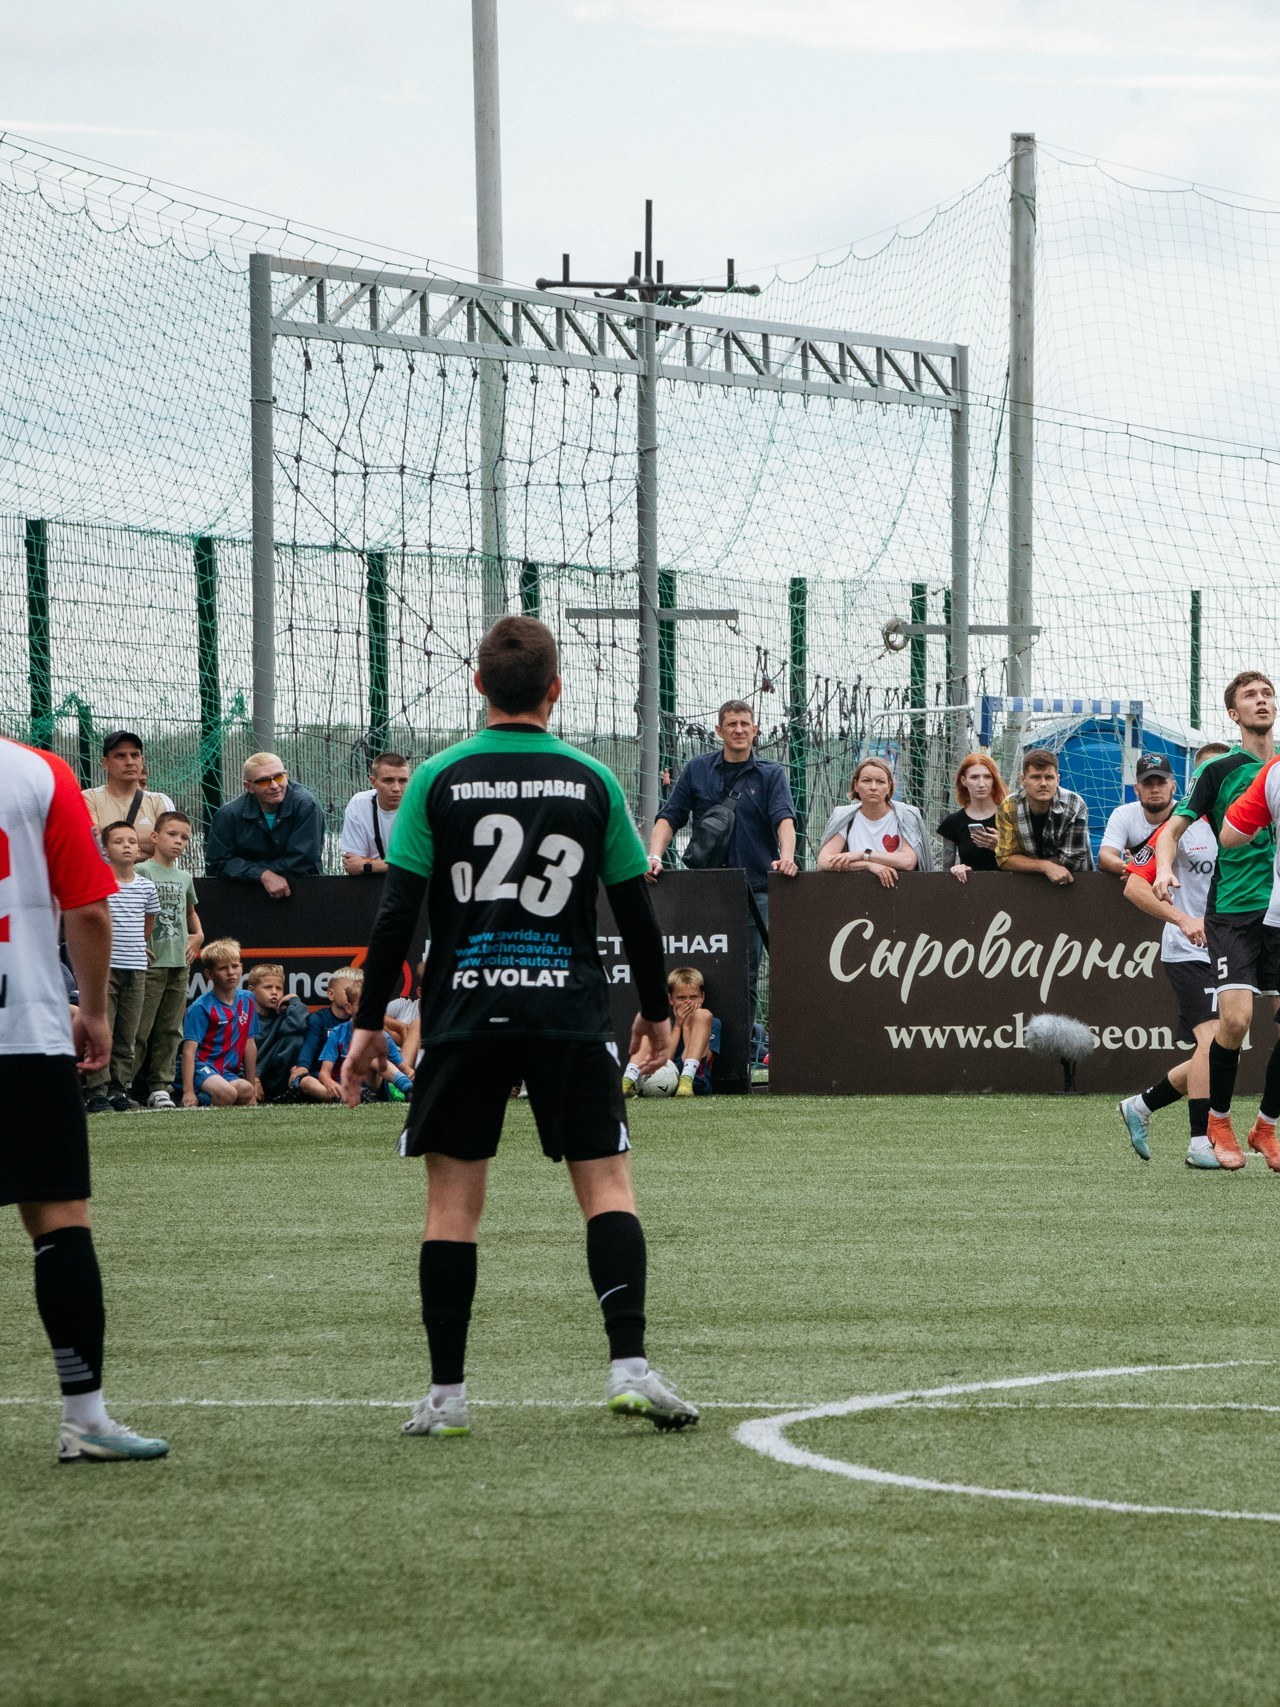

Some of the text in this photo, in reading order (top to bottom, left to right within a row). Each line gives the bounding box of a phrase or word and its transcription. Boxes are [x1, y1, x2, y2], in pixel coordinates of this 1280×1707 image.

[451, 780, 586, 800] ТОЛЬКО ПРАВАЯ
[829, 911, 1161, 1004] Сыроварня
[1217, 956, 1228, 980] 5
[452, 968, 570, 990] FC VOLAT
[1203, 987, 1218, 1012] 7
